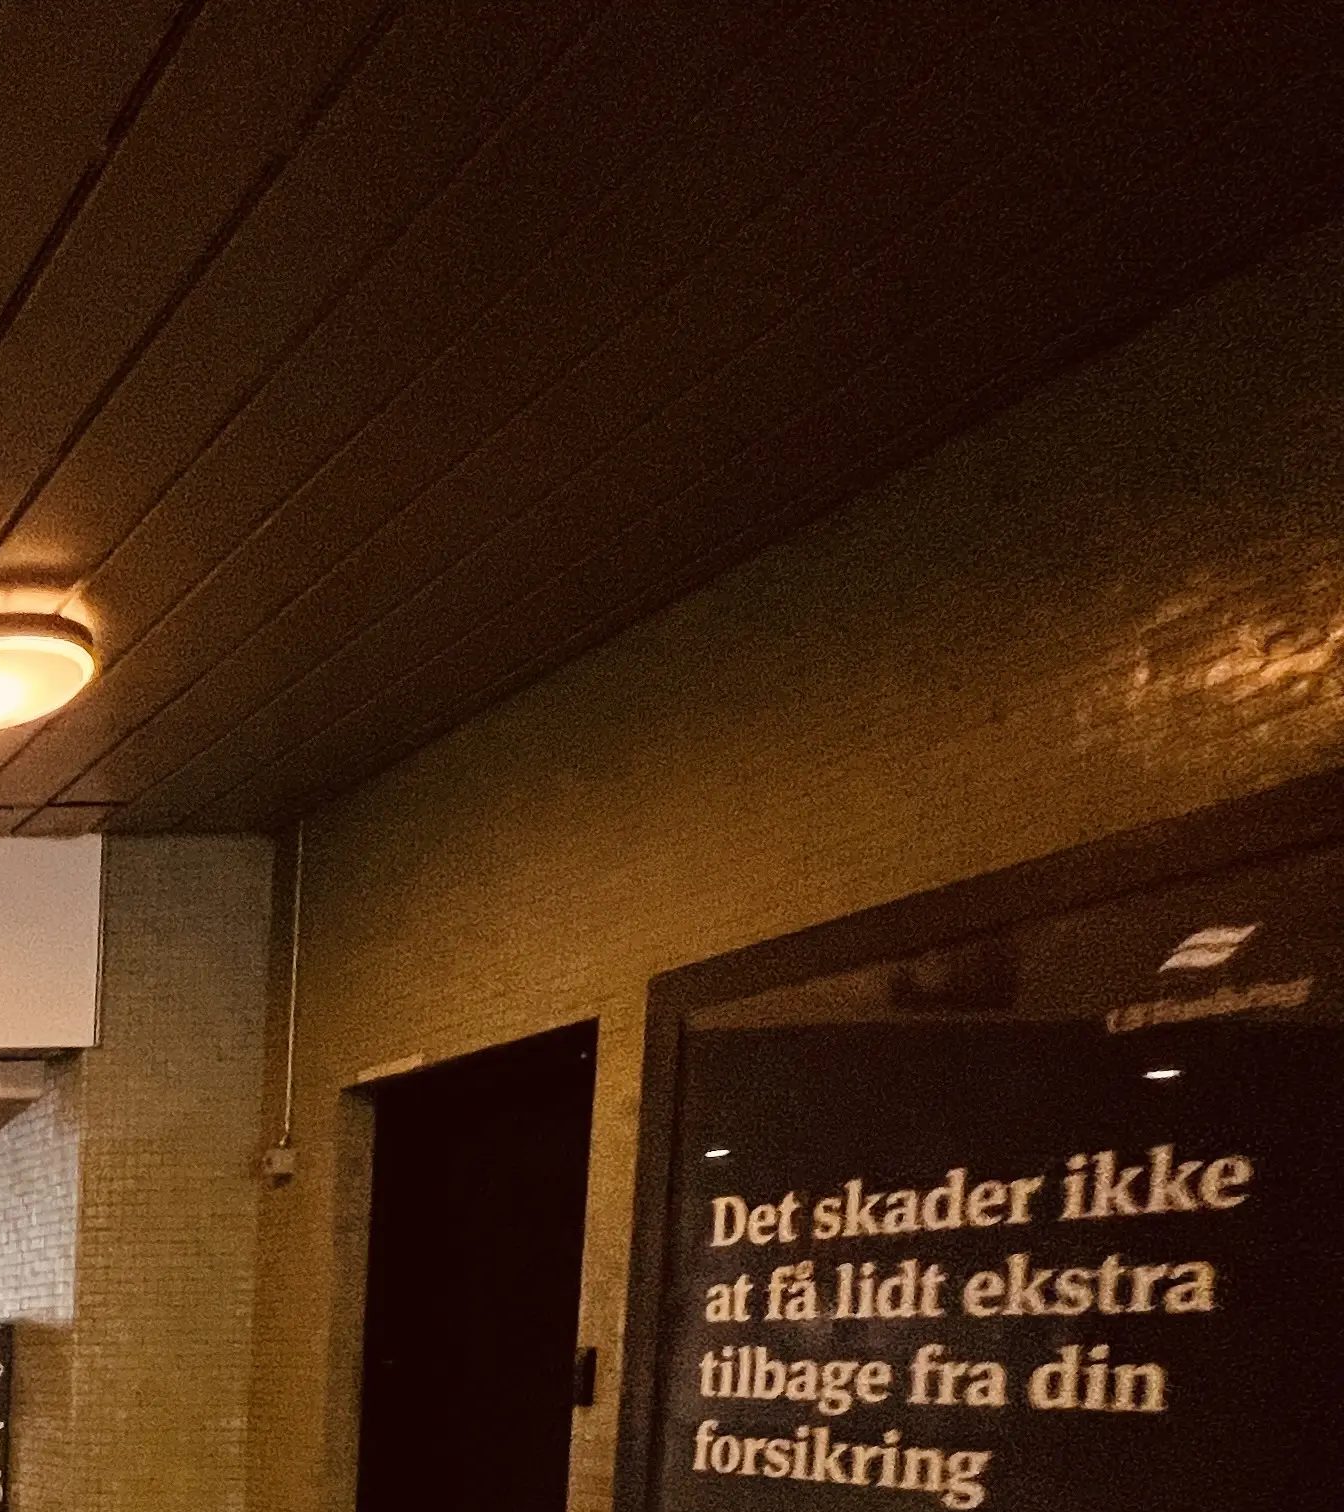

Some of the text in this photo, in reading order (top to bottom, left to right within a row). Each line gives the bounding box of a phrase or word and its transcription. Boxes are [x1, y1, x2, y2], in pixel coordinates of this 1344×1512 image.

[709, 1143, 1255, 1248] Det skader ikke
[705, 1251, 1217, 1322] at få lidt ekstra
[698, 1343, 1168, 1417] tilbage fra din
[691, 1419, 993, 1511] forsikring
